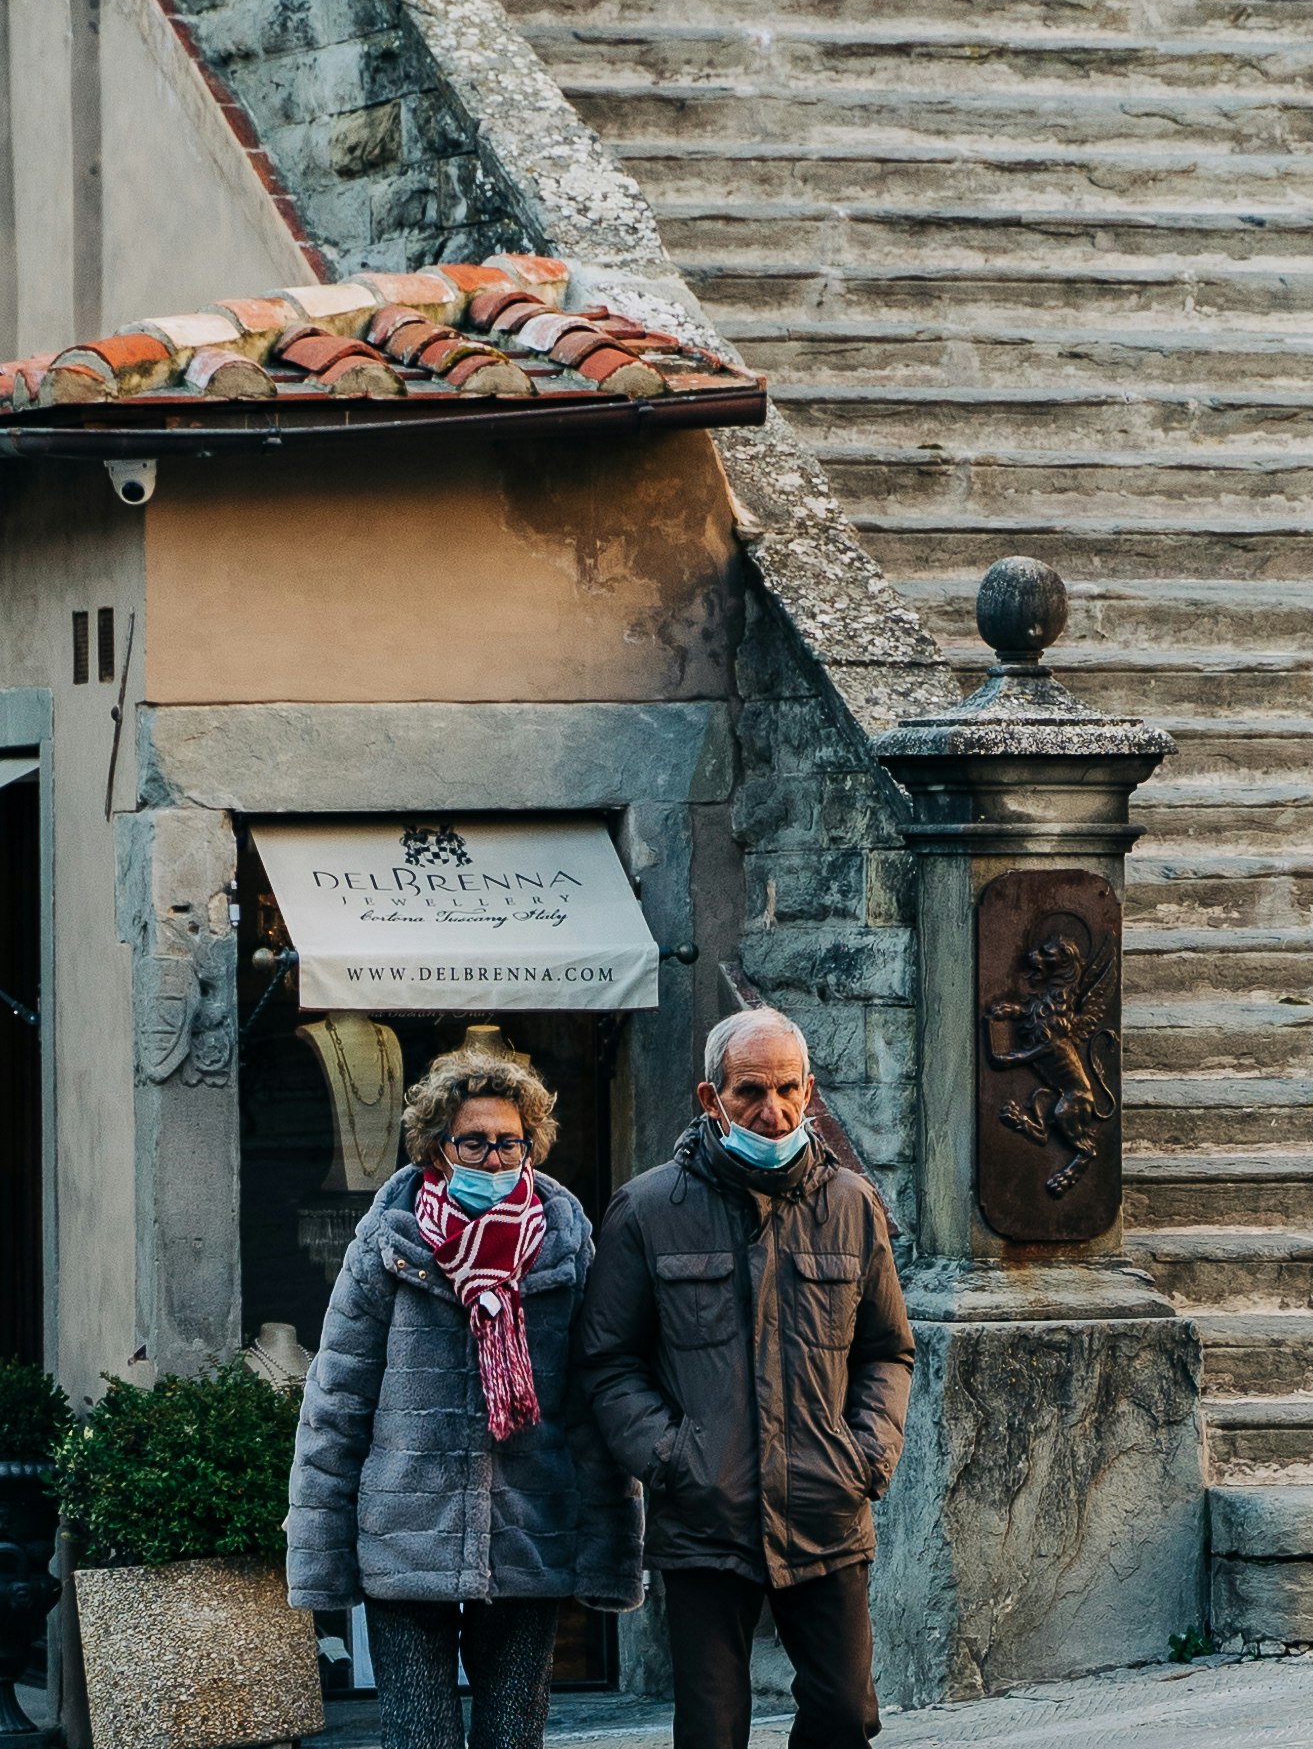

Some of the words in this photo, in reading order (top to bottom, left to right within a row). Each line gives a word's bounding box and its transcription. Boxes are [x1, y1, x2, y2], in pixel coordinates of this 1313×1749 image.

[341, 893, 571, 908] JEWELLERY
[359, 909, 426, 923] Cortona
[436, 907, 509, 929] Tuscany
[511, 908, 569, 928] Italy
[346, 965, 615, 983] WWW.DELBRENNA.COM
